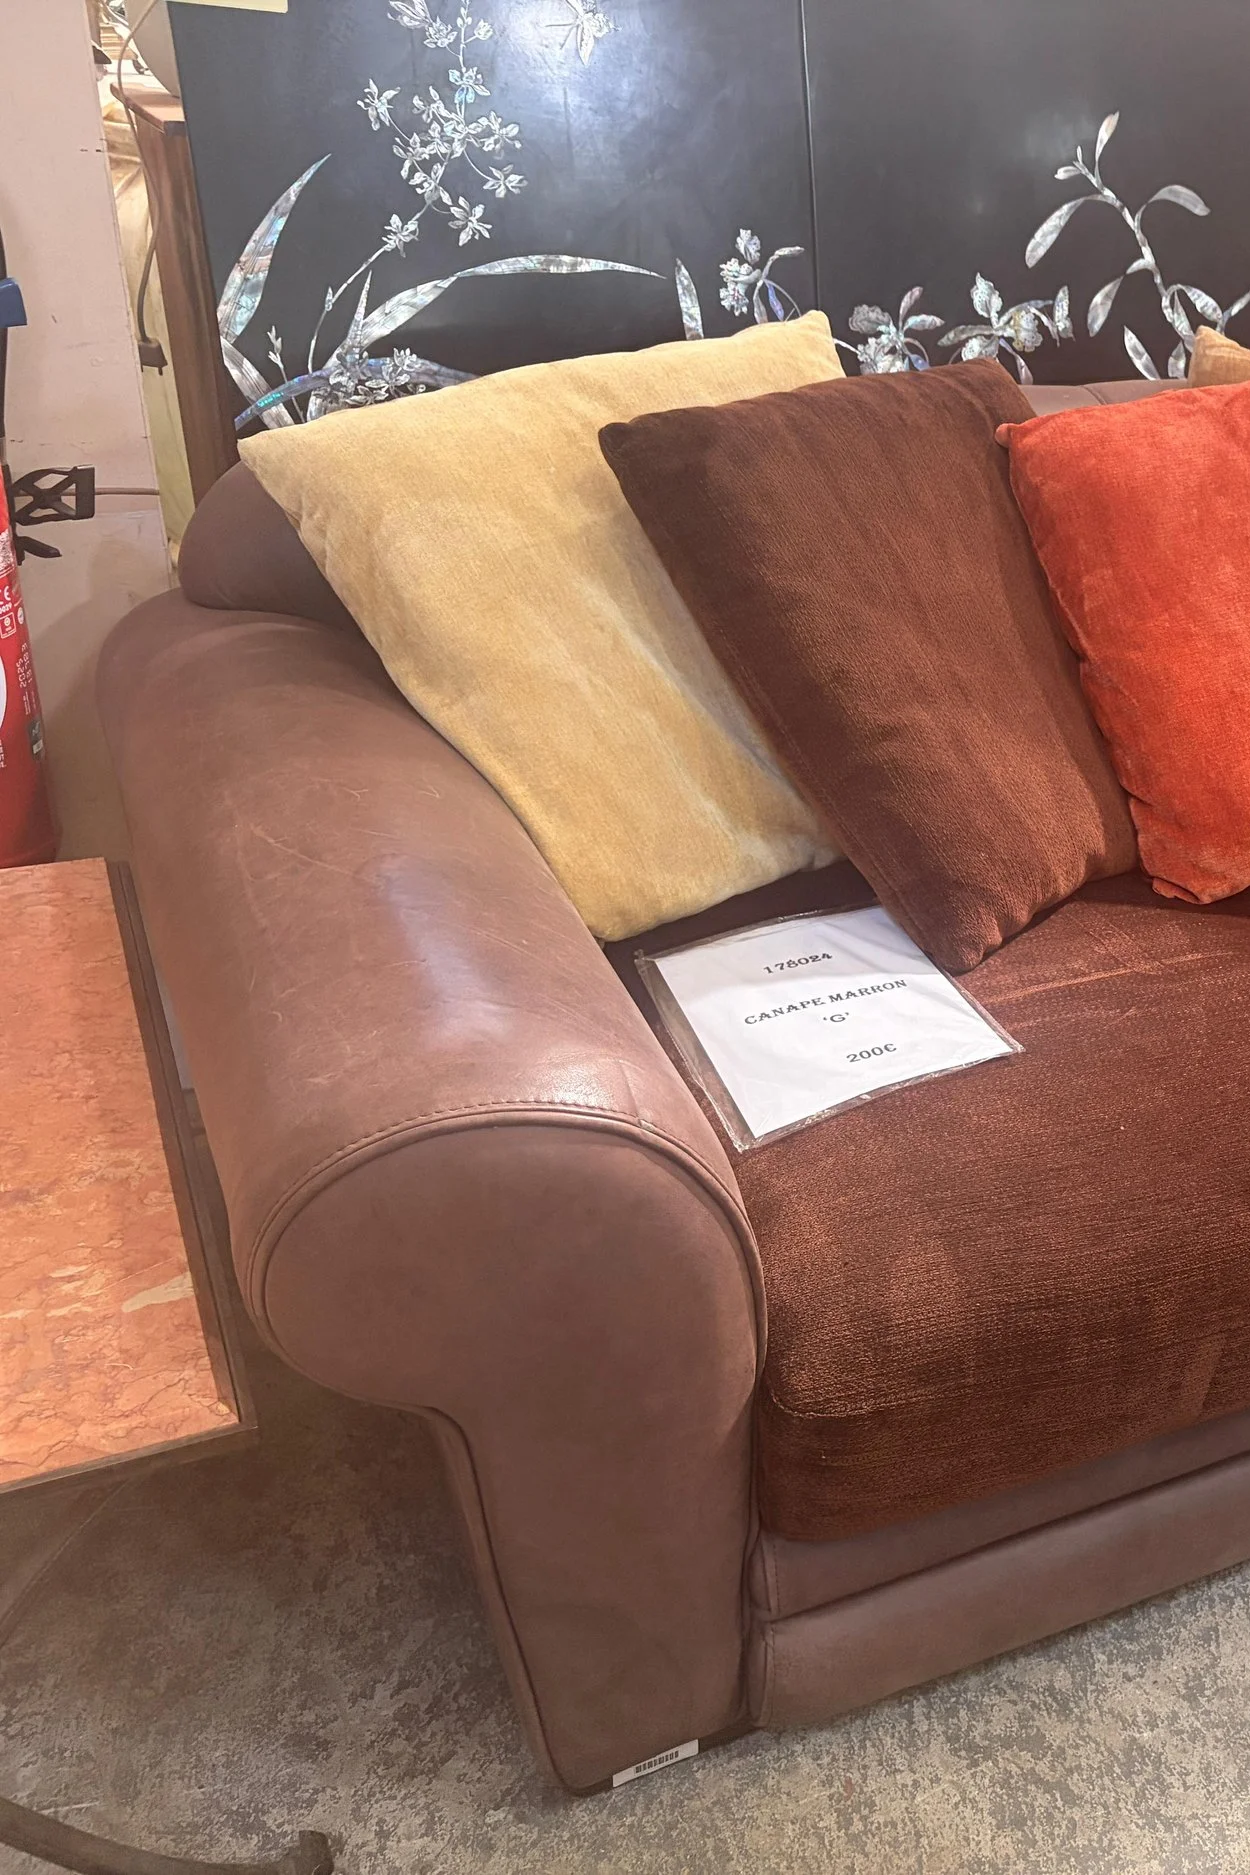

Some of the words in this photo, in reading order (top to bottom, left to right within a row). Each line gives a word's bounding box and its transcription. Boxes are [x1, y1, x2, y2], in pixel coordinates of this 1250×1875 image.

[763, 952, 832, 974] 178024
[744, 997, 826, 1025] CANAPE
[828, 979, 907, 1003] MARRON
